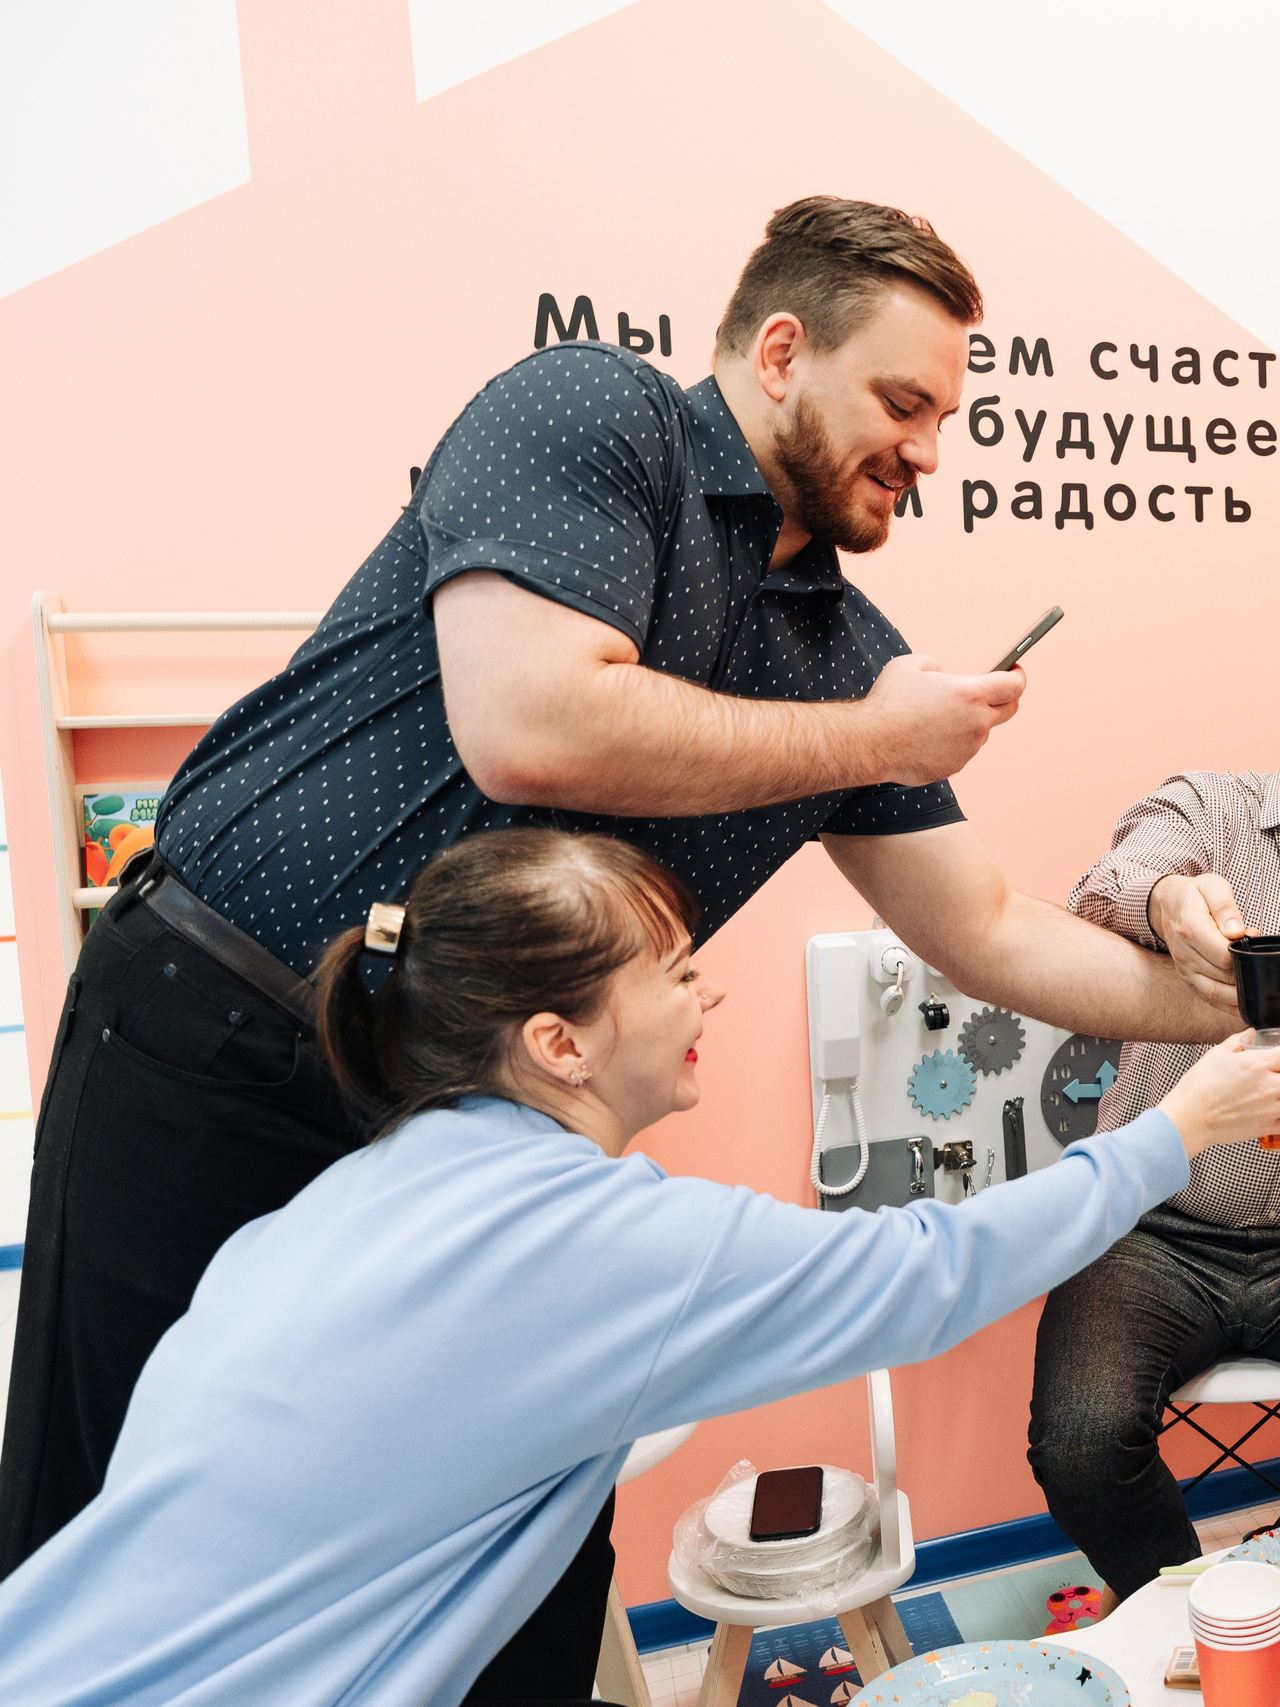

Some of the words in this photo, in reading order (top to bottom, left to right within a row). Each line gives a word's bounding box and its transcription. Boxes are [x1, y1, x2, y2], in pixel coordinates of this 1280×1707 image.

[533, 292, 672, 357] Мы
[967, 333, 1054, 378] ем
[968, 394, 1279, 466] будущее
[962, 479, 1252, 534] радость
[136, 798, 159, 809] МИ
[130, 808, 158, 821] МИ
[1069, 1040, 1086, 1057] 11
[1051, 1063, 1072, 1081] 10
[1049, 1090, 1060, 1107] 9
